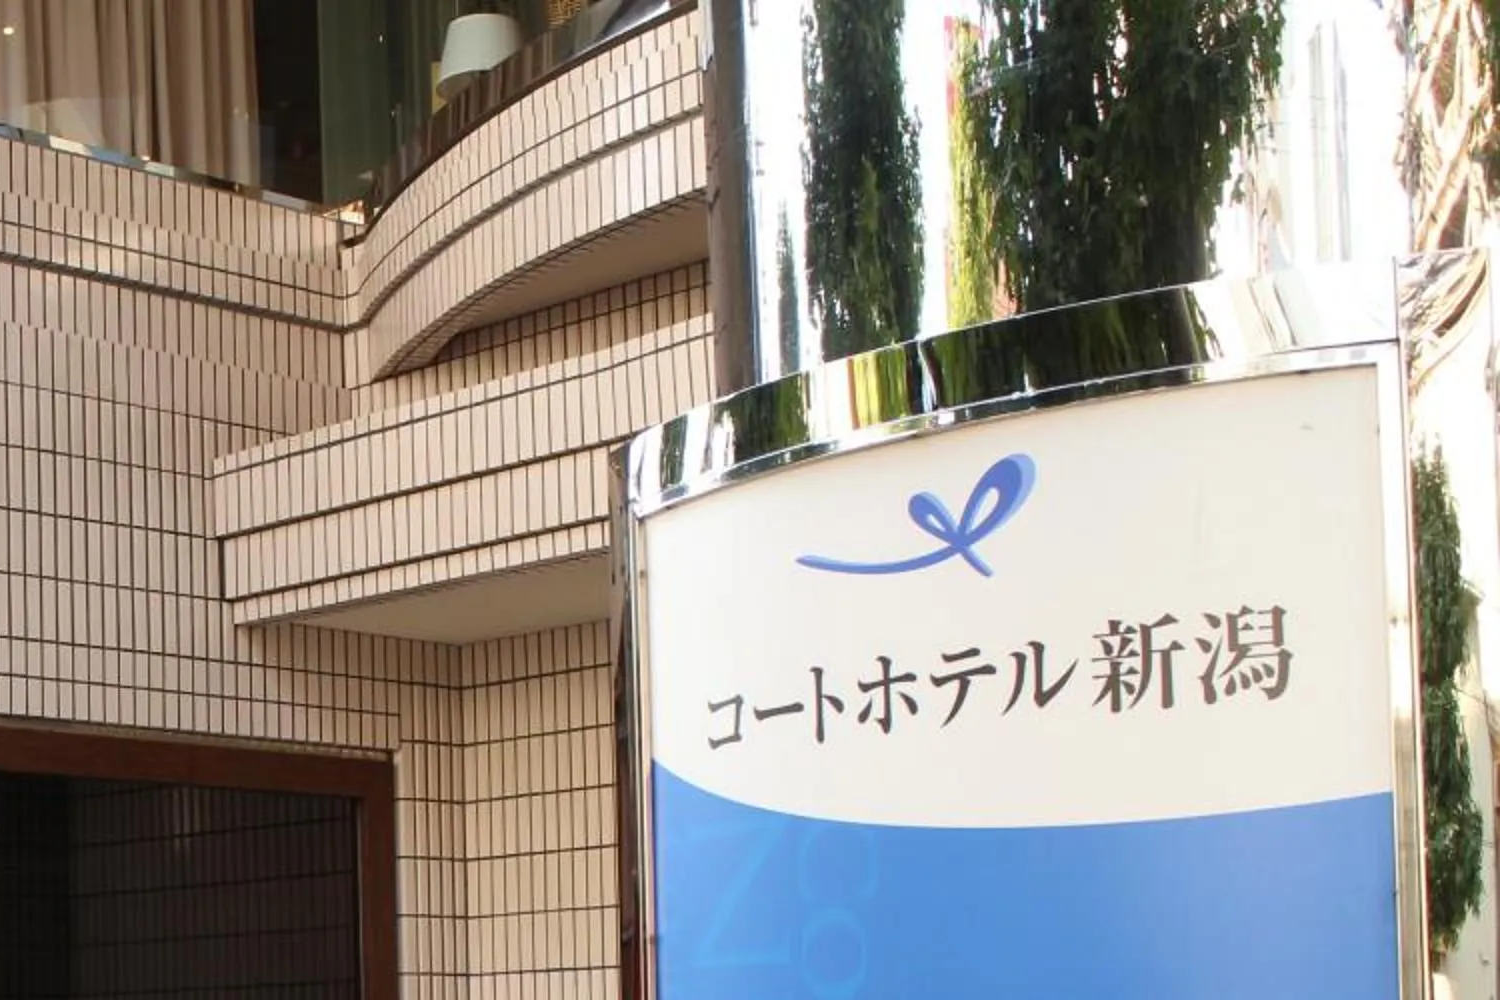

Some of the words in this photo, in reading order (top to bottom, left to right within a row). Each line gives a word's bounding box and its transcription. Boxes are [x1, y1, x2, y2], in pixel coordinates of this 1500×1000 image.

[706, 604, 1294, 750] コートホテル新潟
